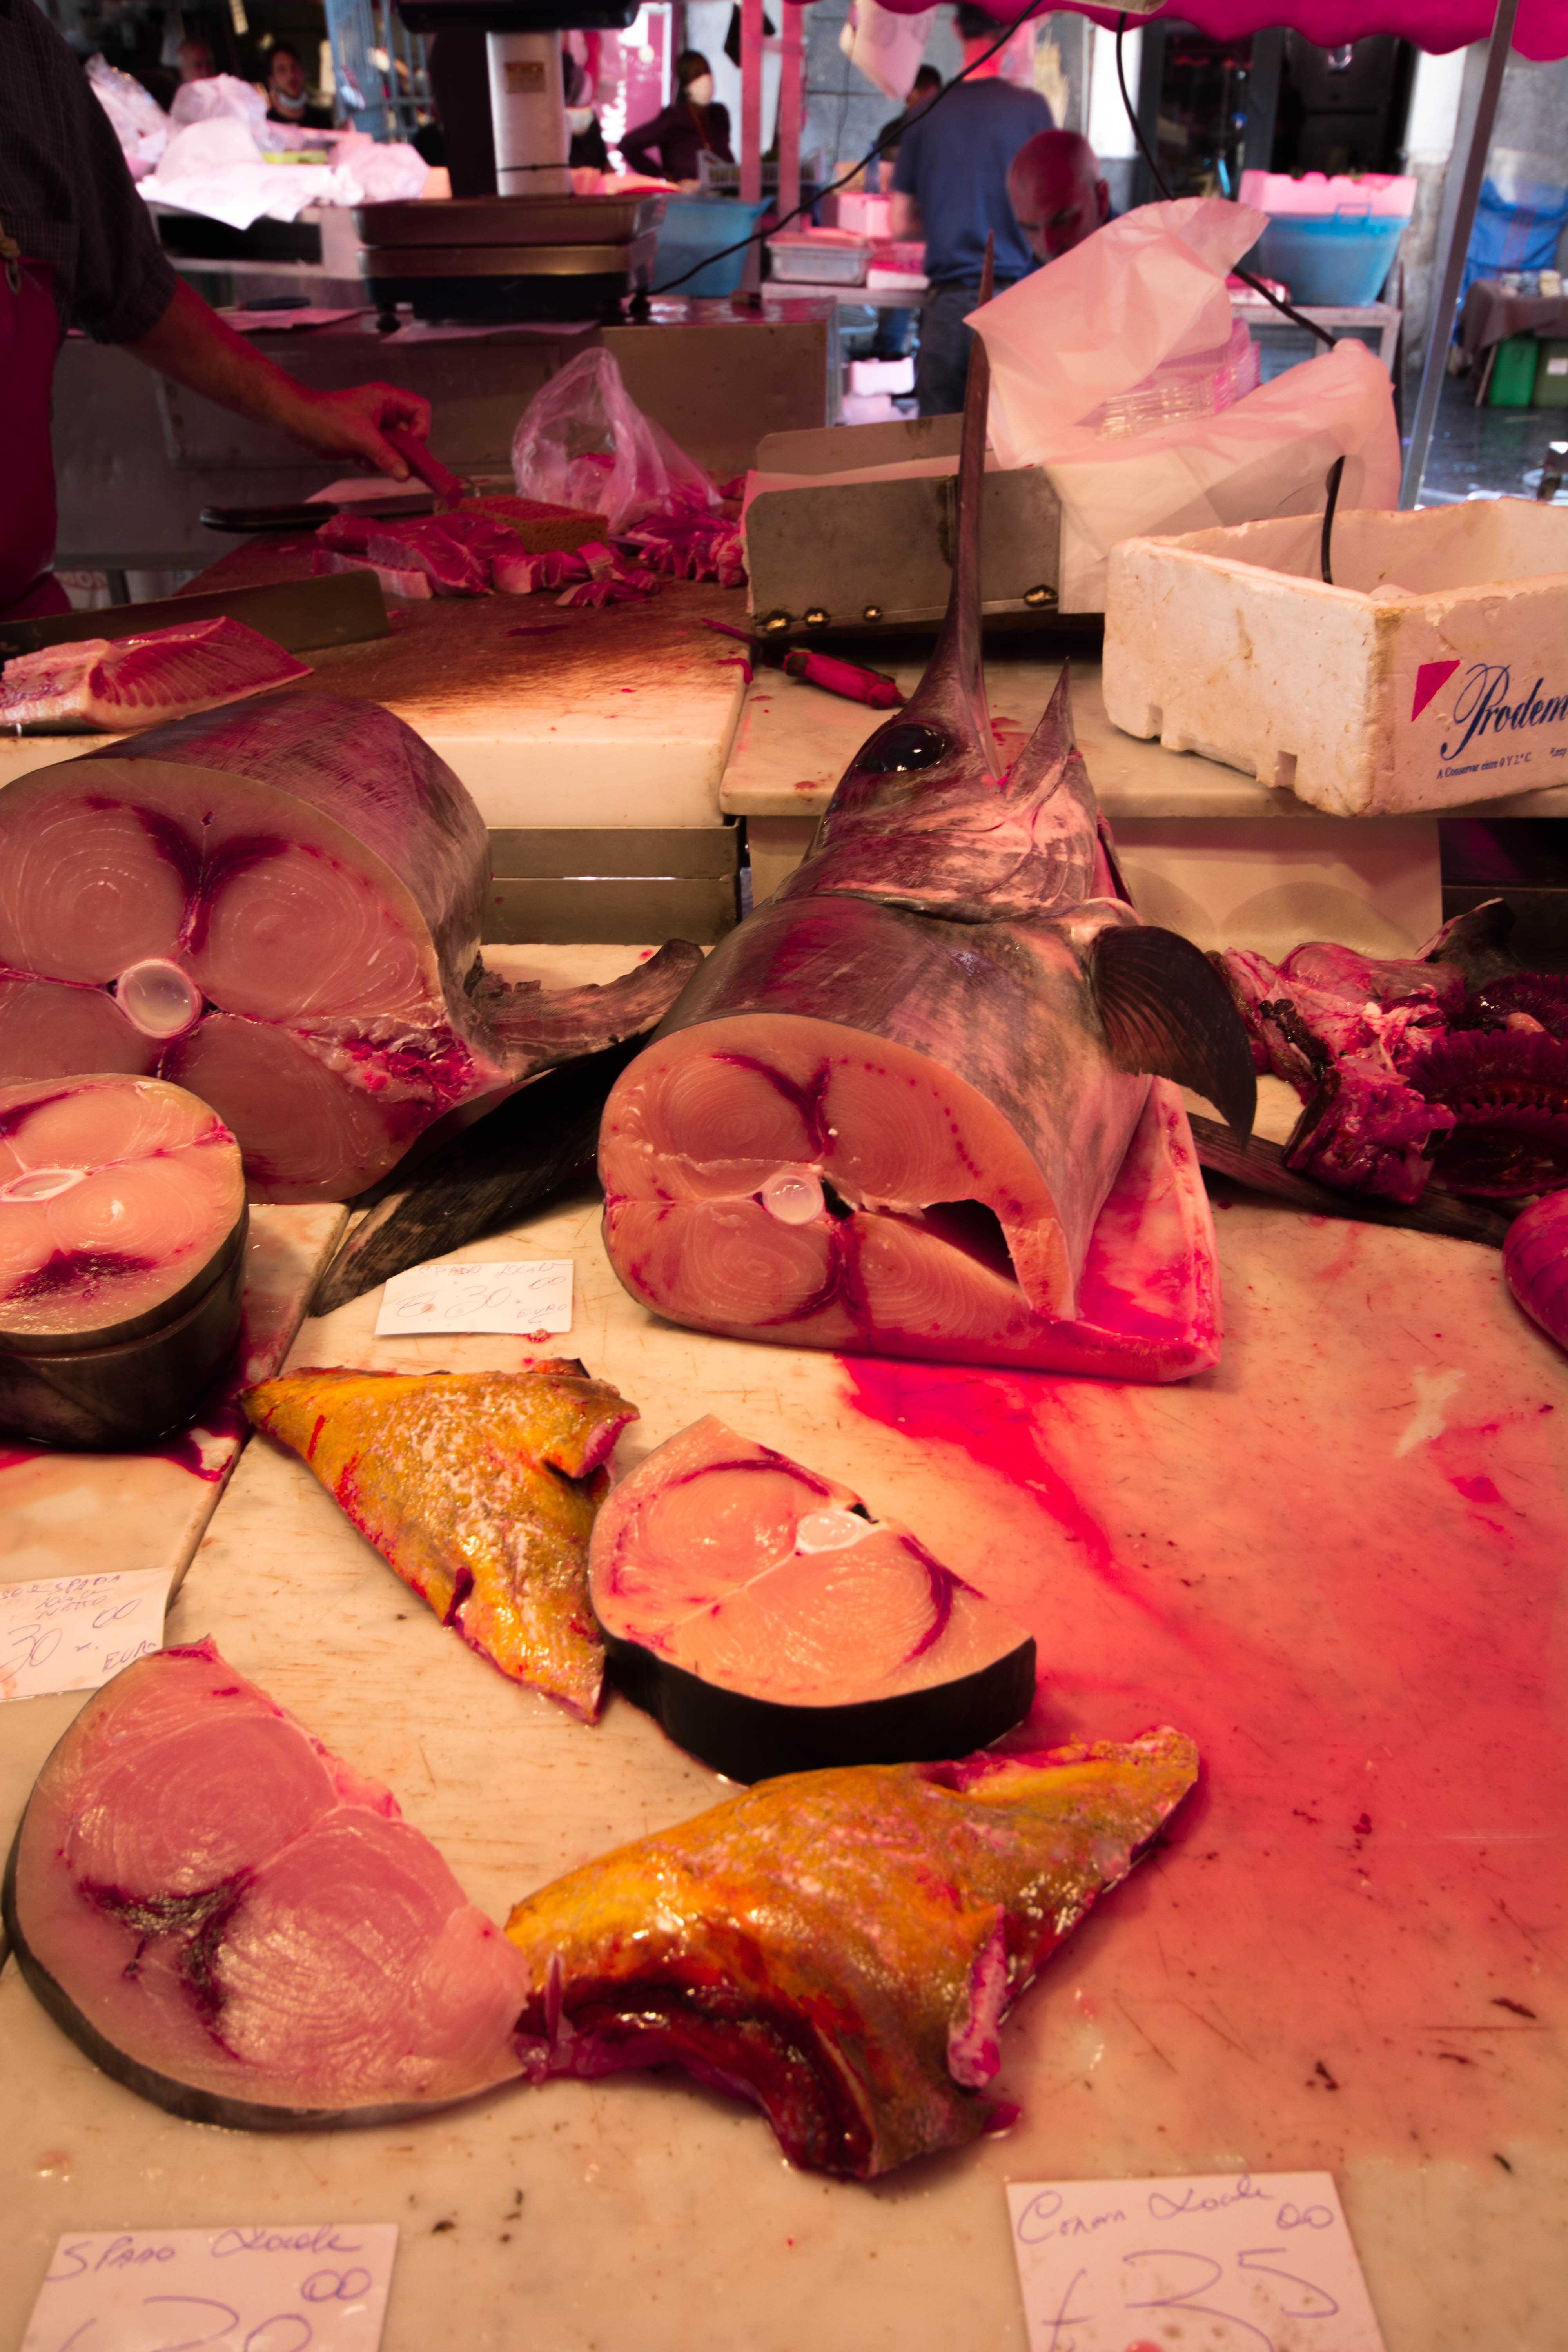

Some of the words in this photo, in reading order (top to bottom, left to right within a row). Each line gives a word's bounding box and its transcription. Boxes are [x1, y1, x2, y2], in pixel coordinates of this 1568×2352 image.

[444, 1285, 511, 1318] 30
[516, 1303, 568, 1319] EURO
[92, 1598, 142, 1628] 00
[301, 2267, 372, 2302] 00
